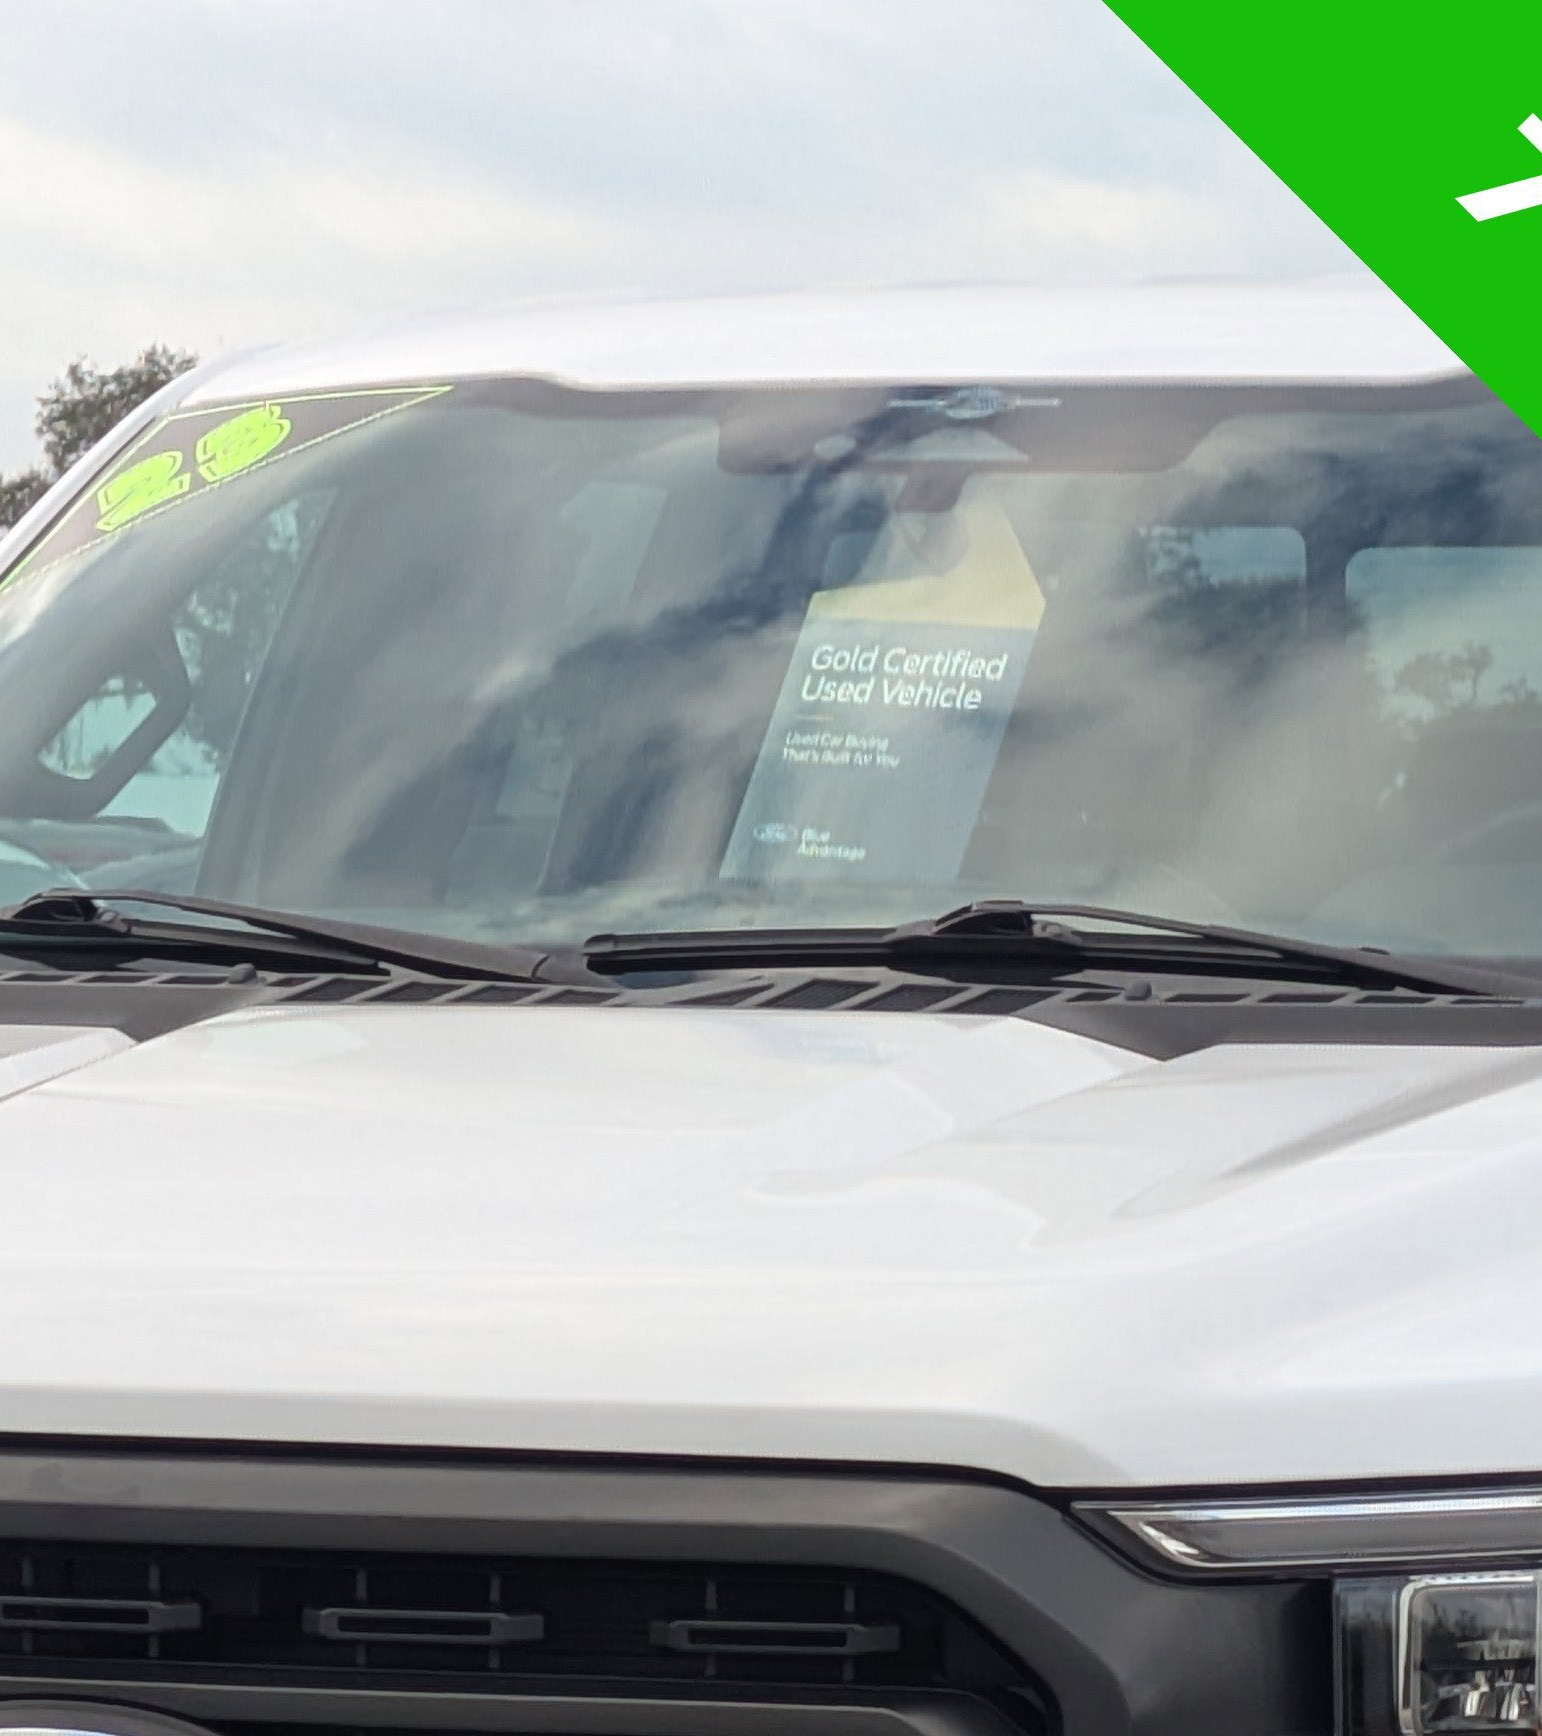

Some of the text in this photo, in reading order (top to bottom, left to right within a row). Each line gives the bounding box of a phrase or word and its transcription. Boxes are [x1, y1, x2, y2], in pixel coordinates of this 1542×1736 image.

[811, 644, 1008, 682] Gold Certified
[801, 675, 982, 710] Used Vehicle
